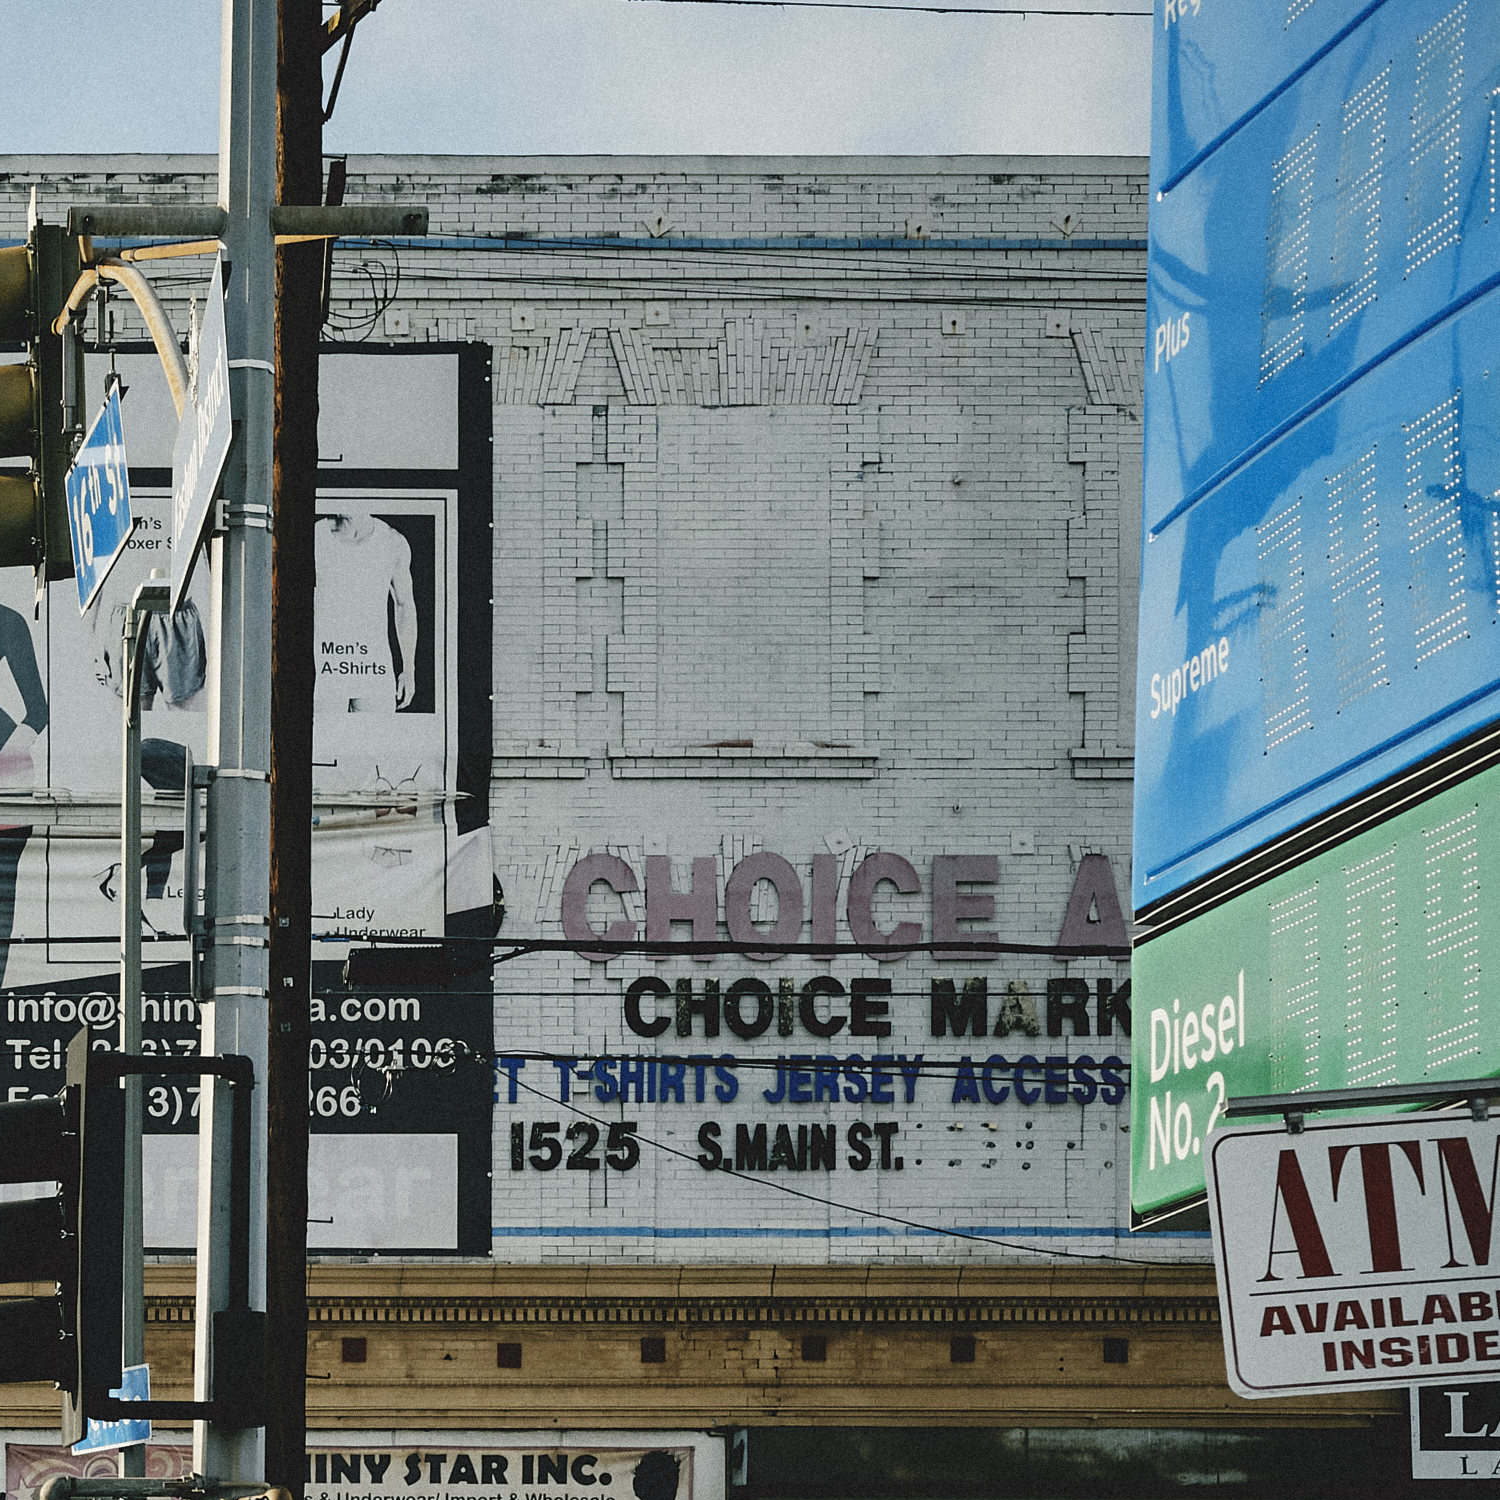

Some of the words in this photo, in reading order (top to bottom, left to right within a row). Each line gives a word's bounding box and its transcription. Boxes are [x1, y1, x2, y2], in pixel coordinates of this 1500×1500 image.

[1154, 311, 1191, 374] Plus
[104, 431, 125, 516] St
[127, 538, 162, 550] oxer
[320, 640, 368, 656] Men's
[320, 660, 387, 676] A-Shirts
[1149, 635, 1230, 720] Supreme
[336, 906, 375, 922] Lady
[561, 851, 999, 963] CHOICE
[624, 975, 893, 1039] CHOICE
[1149, 968, 1246, 1083] Diesel
[493, 1054, 526, 1104] T
[553, 1053, 740, 1105] T-SHIRTS
[763, 1054, 925, 1105] JERSEY
[510, 1120, 641, 1172] 1525
[1148, 1095, 1200, 1171] No.
[403, 1452, 509, 1487] STAR
[521, 1453, 613, 1486] INC.
